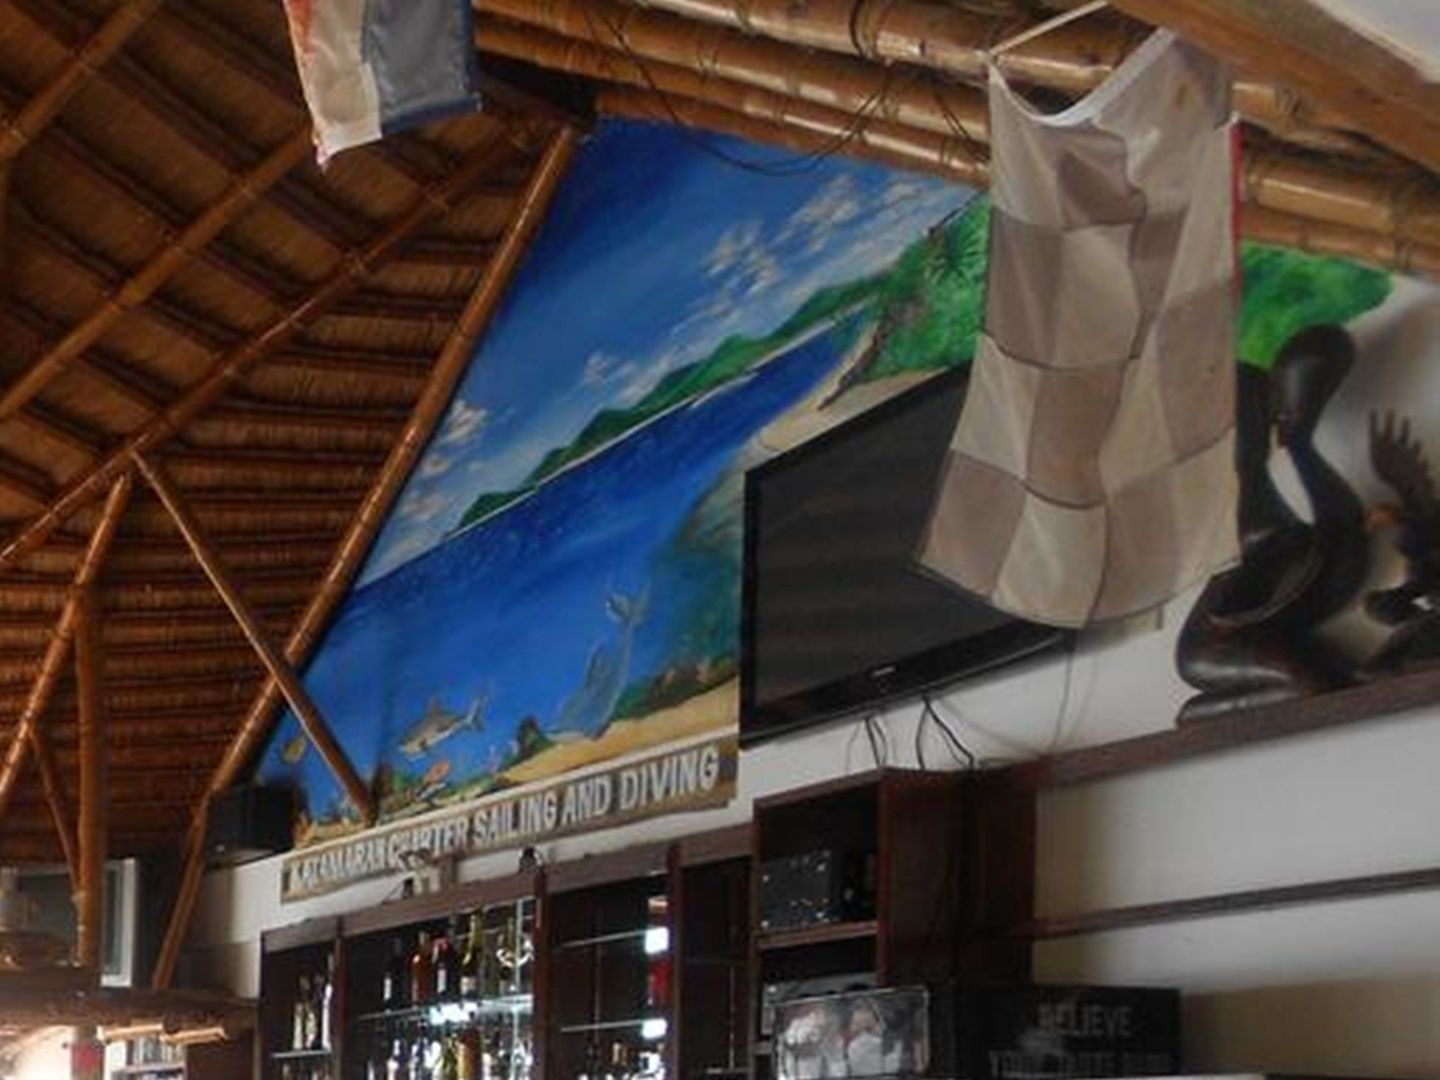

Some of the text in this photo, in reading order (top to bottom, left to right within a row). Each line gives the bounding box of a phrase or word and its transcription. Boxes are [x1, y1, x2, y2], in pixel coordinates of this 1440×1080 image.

[472, 791, 557, 848] SAILING
[562, 776, 612, 826] AND
[620, 745, 720, 810] DIVING
[1036, 1002, 1134, 1037] BELIEVE
